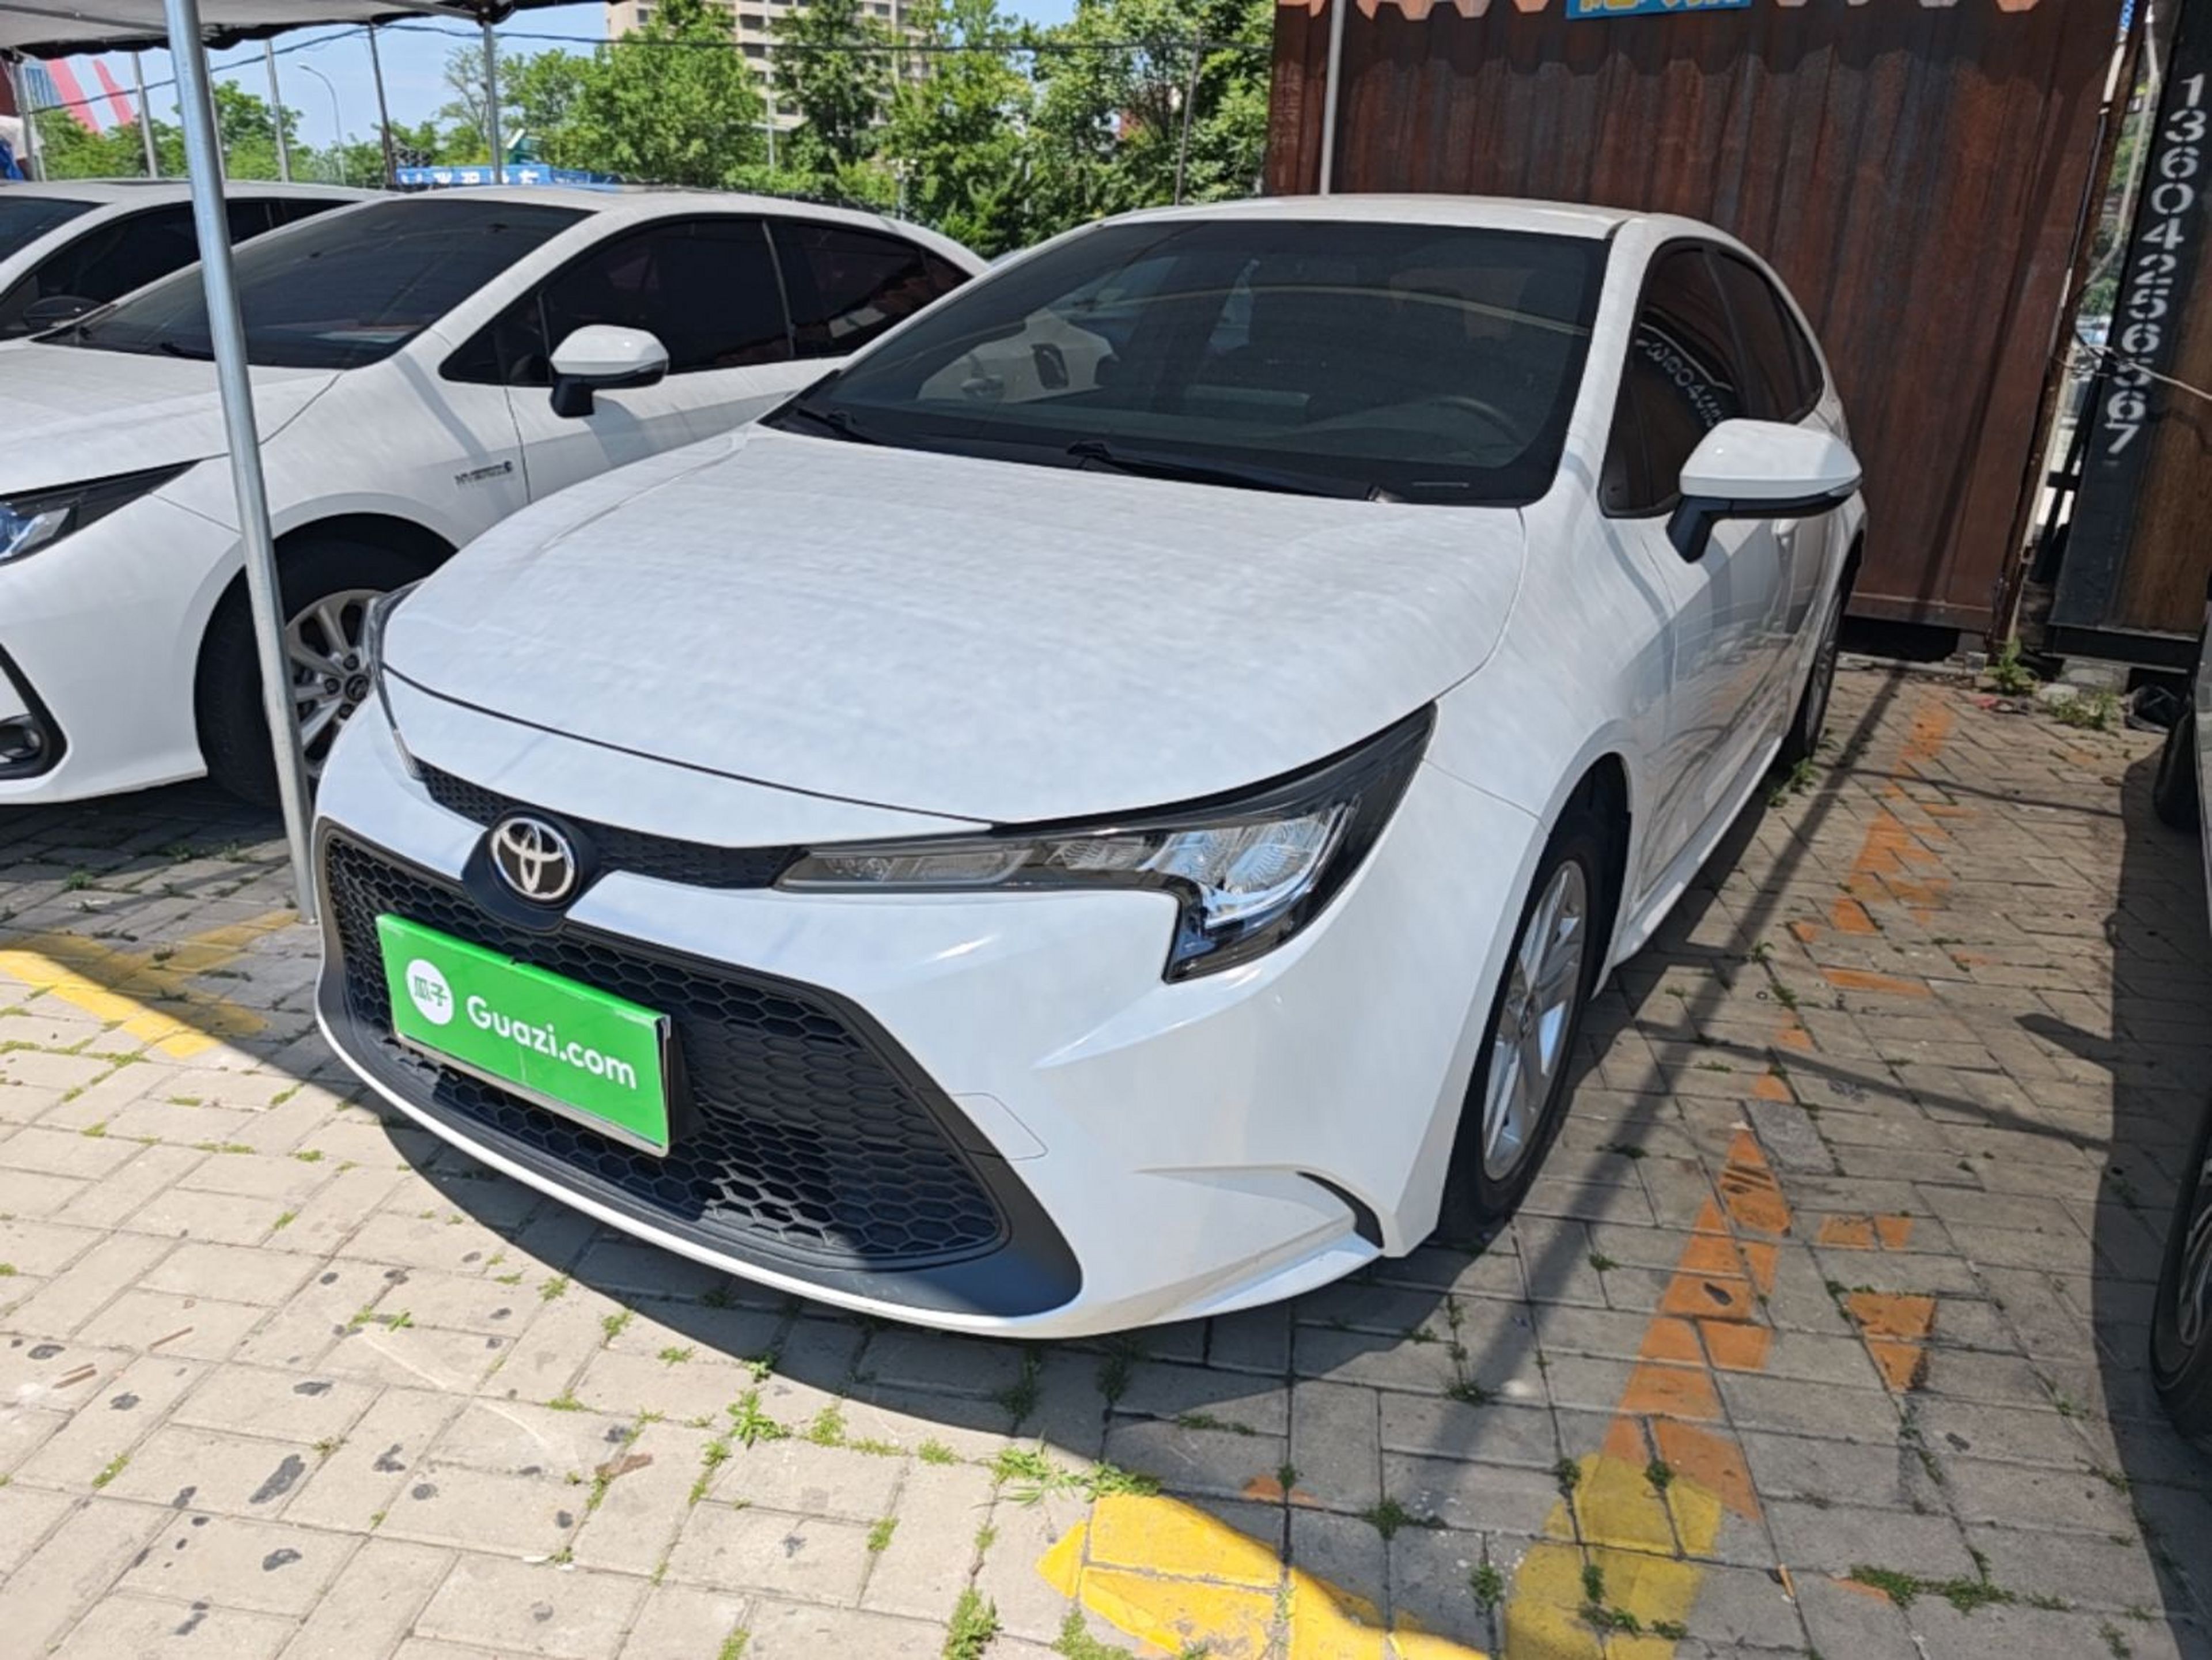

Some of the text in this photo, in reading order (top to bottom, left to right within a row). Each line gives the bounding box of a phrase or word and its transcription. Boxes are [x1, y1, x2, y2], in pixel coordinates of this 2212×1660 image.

[2105, 73, 2207, 453] 13604256567
[414, 975, 448, 1007] 瓜子
[467, 995, 637, 1090] Guazi.com
